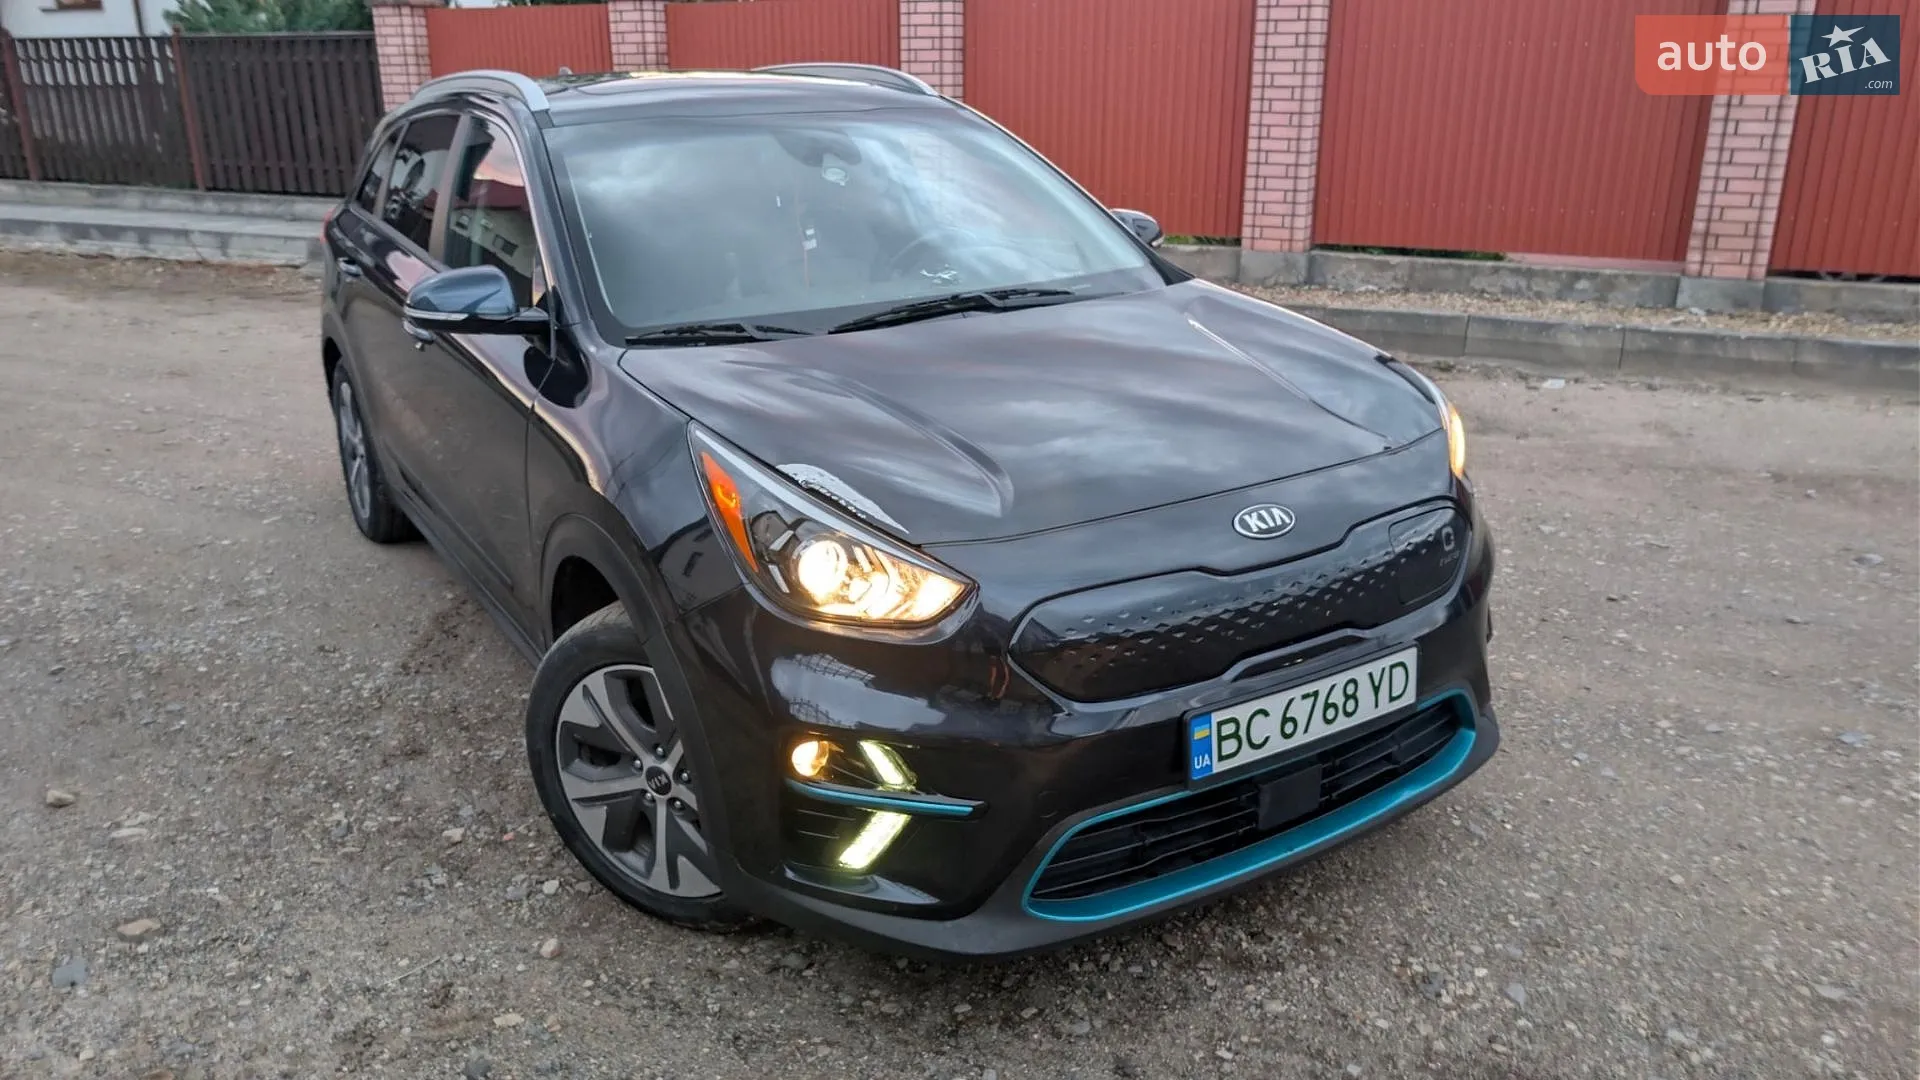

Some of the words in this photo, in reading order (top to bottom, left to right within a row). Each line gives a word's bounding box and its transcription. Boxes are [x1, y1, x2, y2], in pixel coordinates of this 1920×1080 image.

[1243, 507, 1291, 532] KIA
[1216, 708, 1271, 762] BC
[1280, 677, 1359, 740] 6768
[1368, 661, 1409, 709] YD
[1194, 752, 1211, 769] UA
